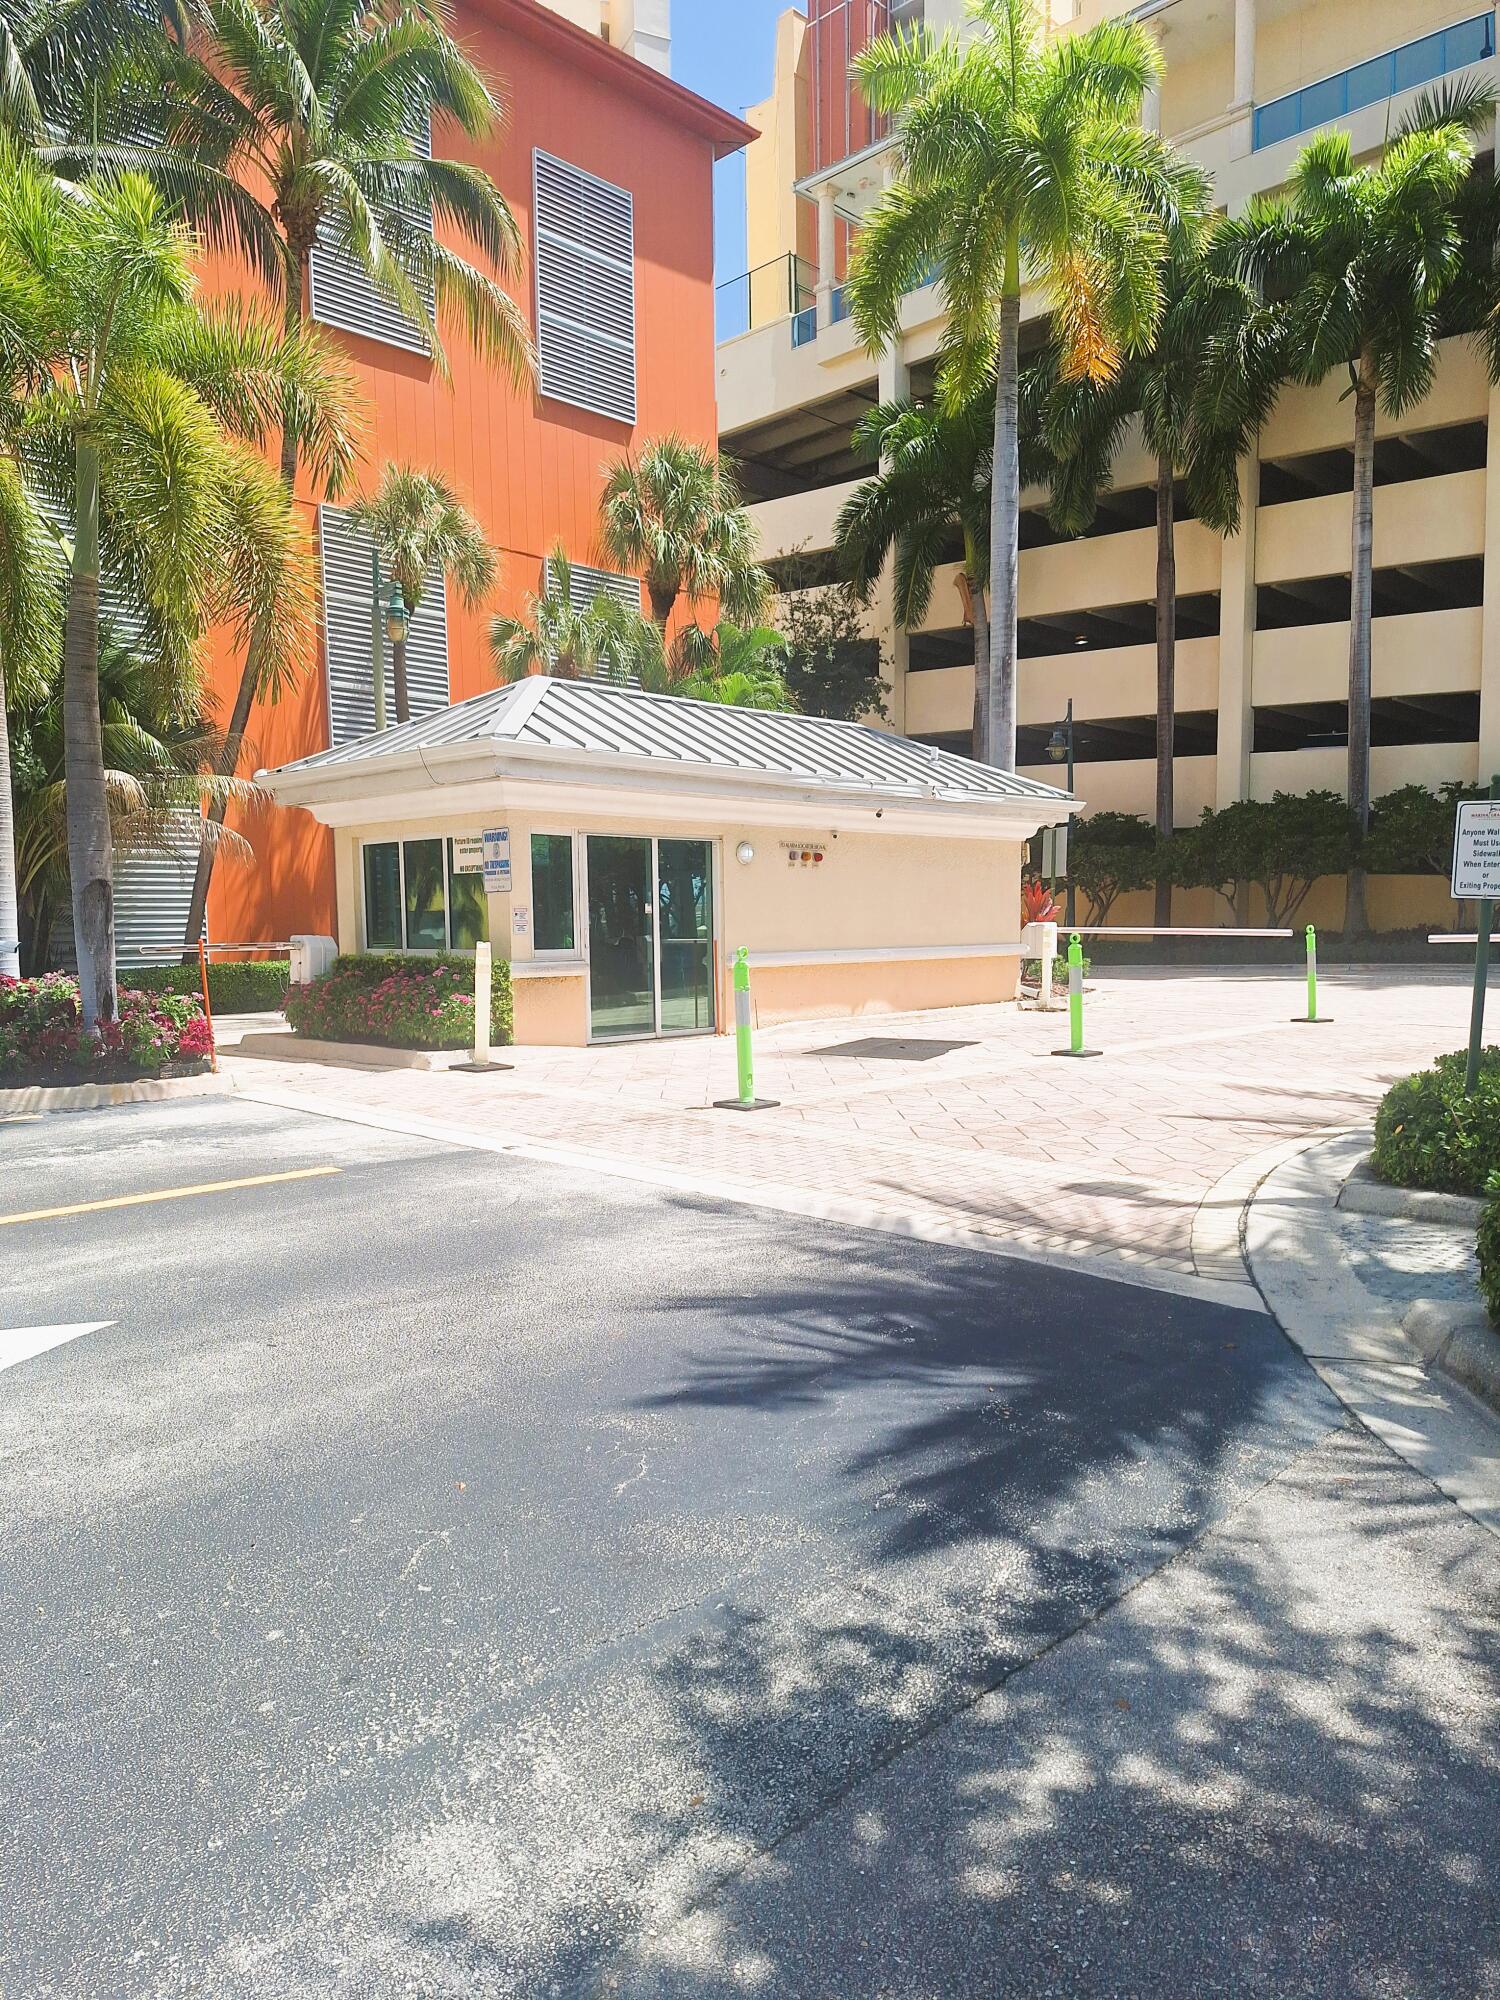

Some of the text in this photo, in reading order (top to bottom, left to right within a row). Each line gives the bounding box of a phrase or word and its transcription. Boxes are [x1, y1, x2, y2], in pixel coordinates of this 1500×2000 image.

[484, 831, 508, 843] WARNING!
[1462, 828, 1485, 837] Anyone
[1459, 881, 1481, 890] Exiting
